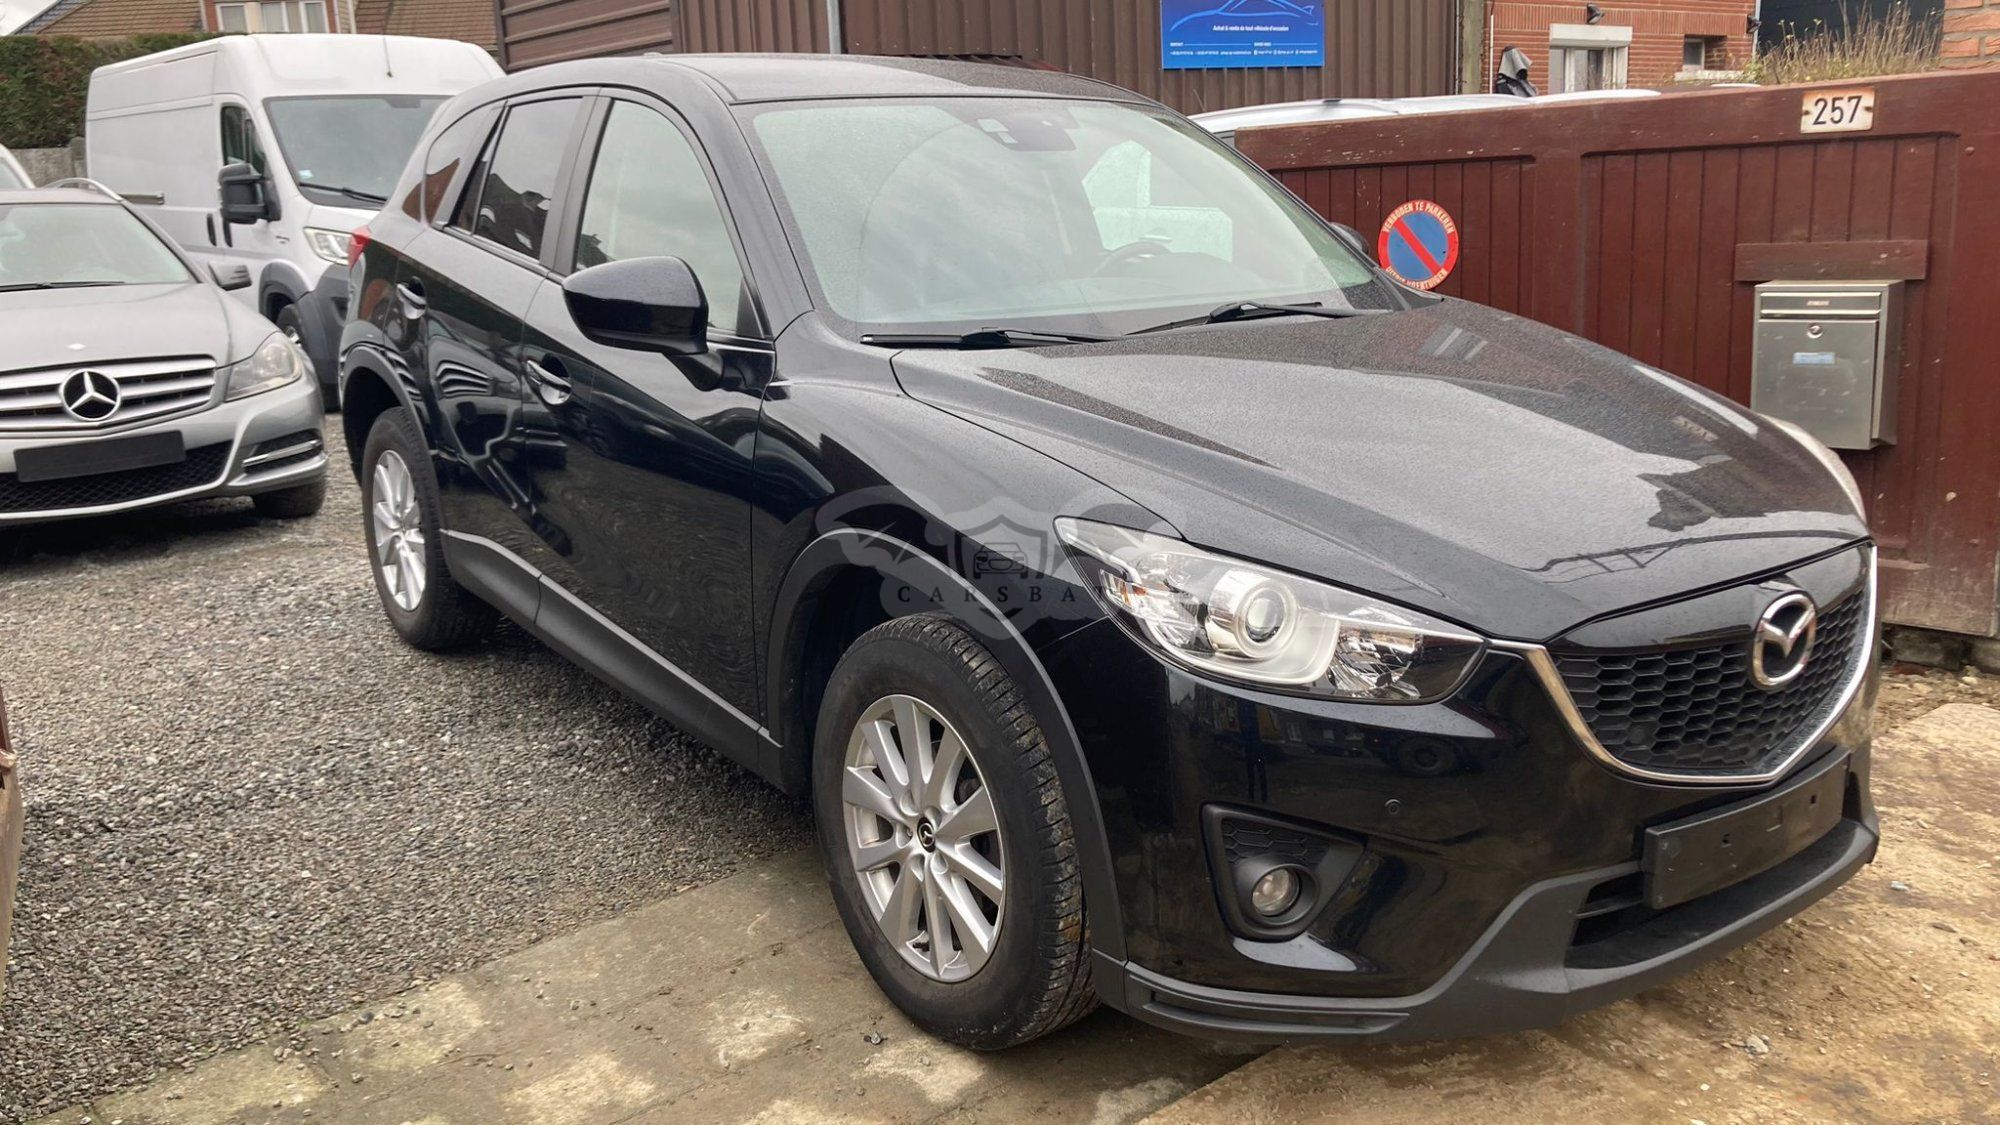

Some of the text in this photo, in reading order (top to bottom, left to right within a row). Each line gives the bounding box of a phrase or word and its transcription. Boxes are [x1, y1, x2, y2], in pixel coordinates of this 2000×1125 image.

[1812, 95, 1863, 126] 257
[1382, 201, 1455, 234] VERBODEN TE PARKEREN
